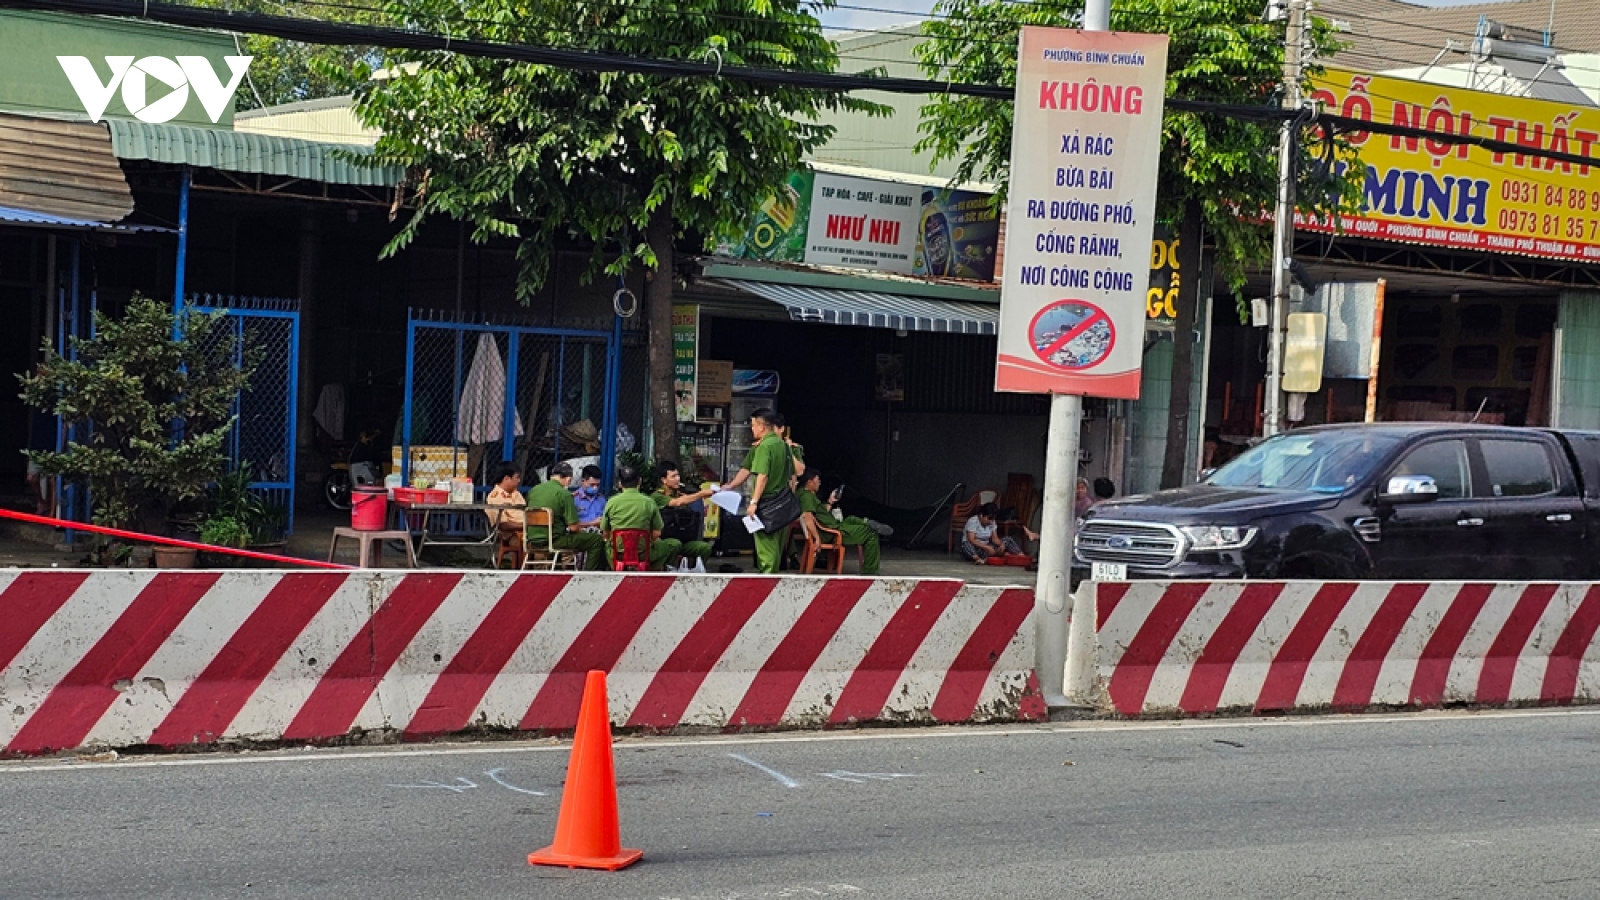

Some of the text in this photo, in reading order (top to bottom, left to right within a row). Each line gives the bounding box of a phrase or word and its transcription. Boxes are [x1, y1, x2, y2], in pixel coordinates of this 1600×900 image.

[1086, 50, 1109, 63] BÌNH
[1040, 77, 1143, 115] KHÔNG
[1061, 129, 1114, 156] XẢ RÁC
[1390, 97, 1471, 167] NỘI
[1488, 112, 1600, 176] THẤT
[1089, 166, 1113, 190] BÃI
[1361, 165, 1490, 225] MINH
[1501, 180, 1600, 213] 0931 84 88 9
[1027, 197, 1136, 227] RA ĐƯỜNG PHỐ,
[1499, 209, 1600, 241] 0973 81 35 7
[826, 214, 867, 242] NHƯ
[869, 218, 901, 246] NHI
[1036, 227, 1122, 260] CỐNG RÃNH,
[1021, 264, 1133, 295] NƠI CÔNG CỘNG
